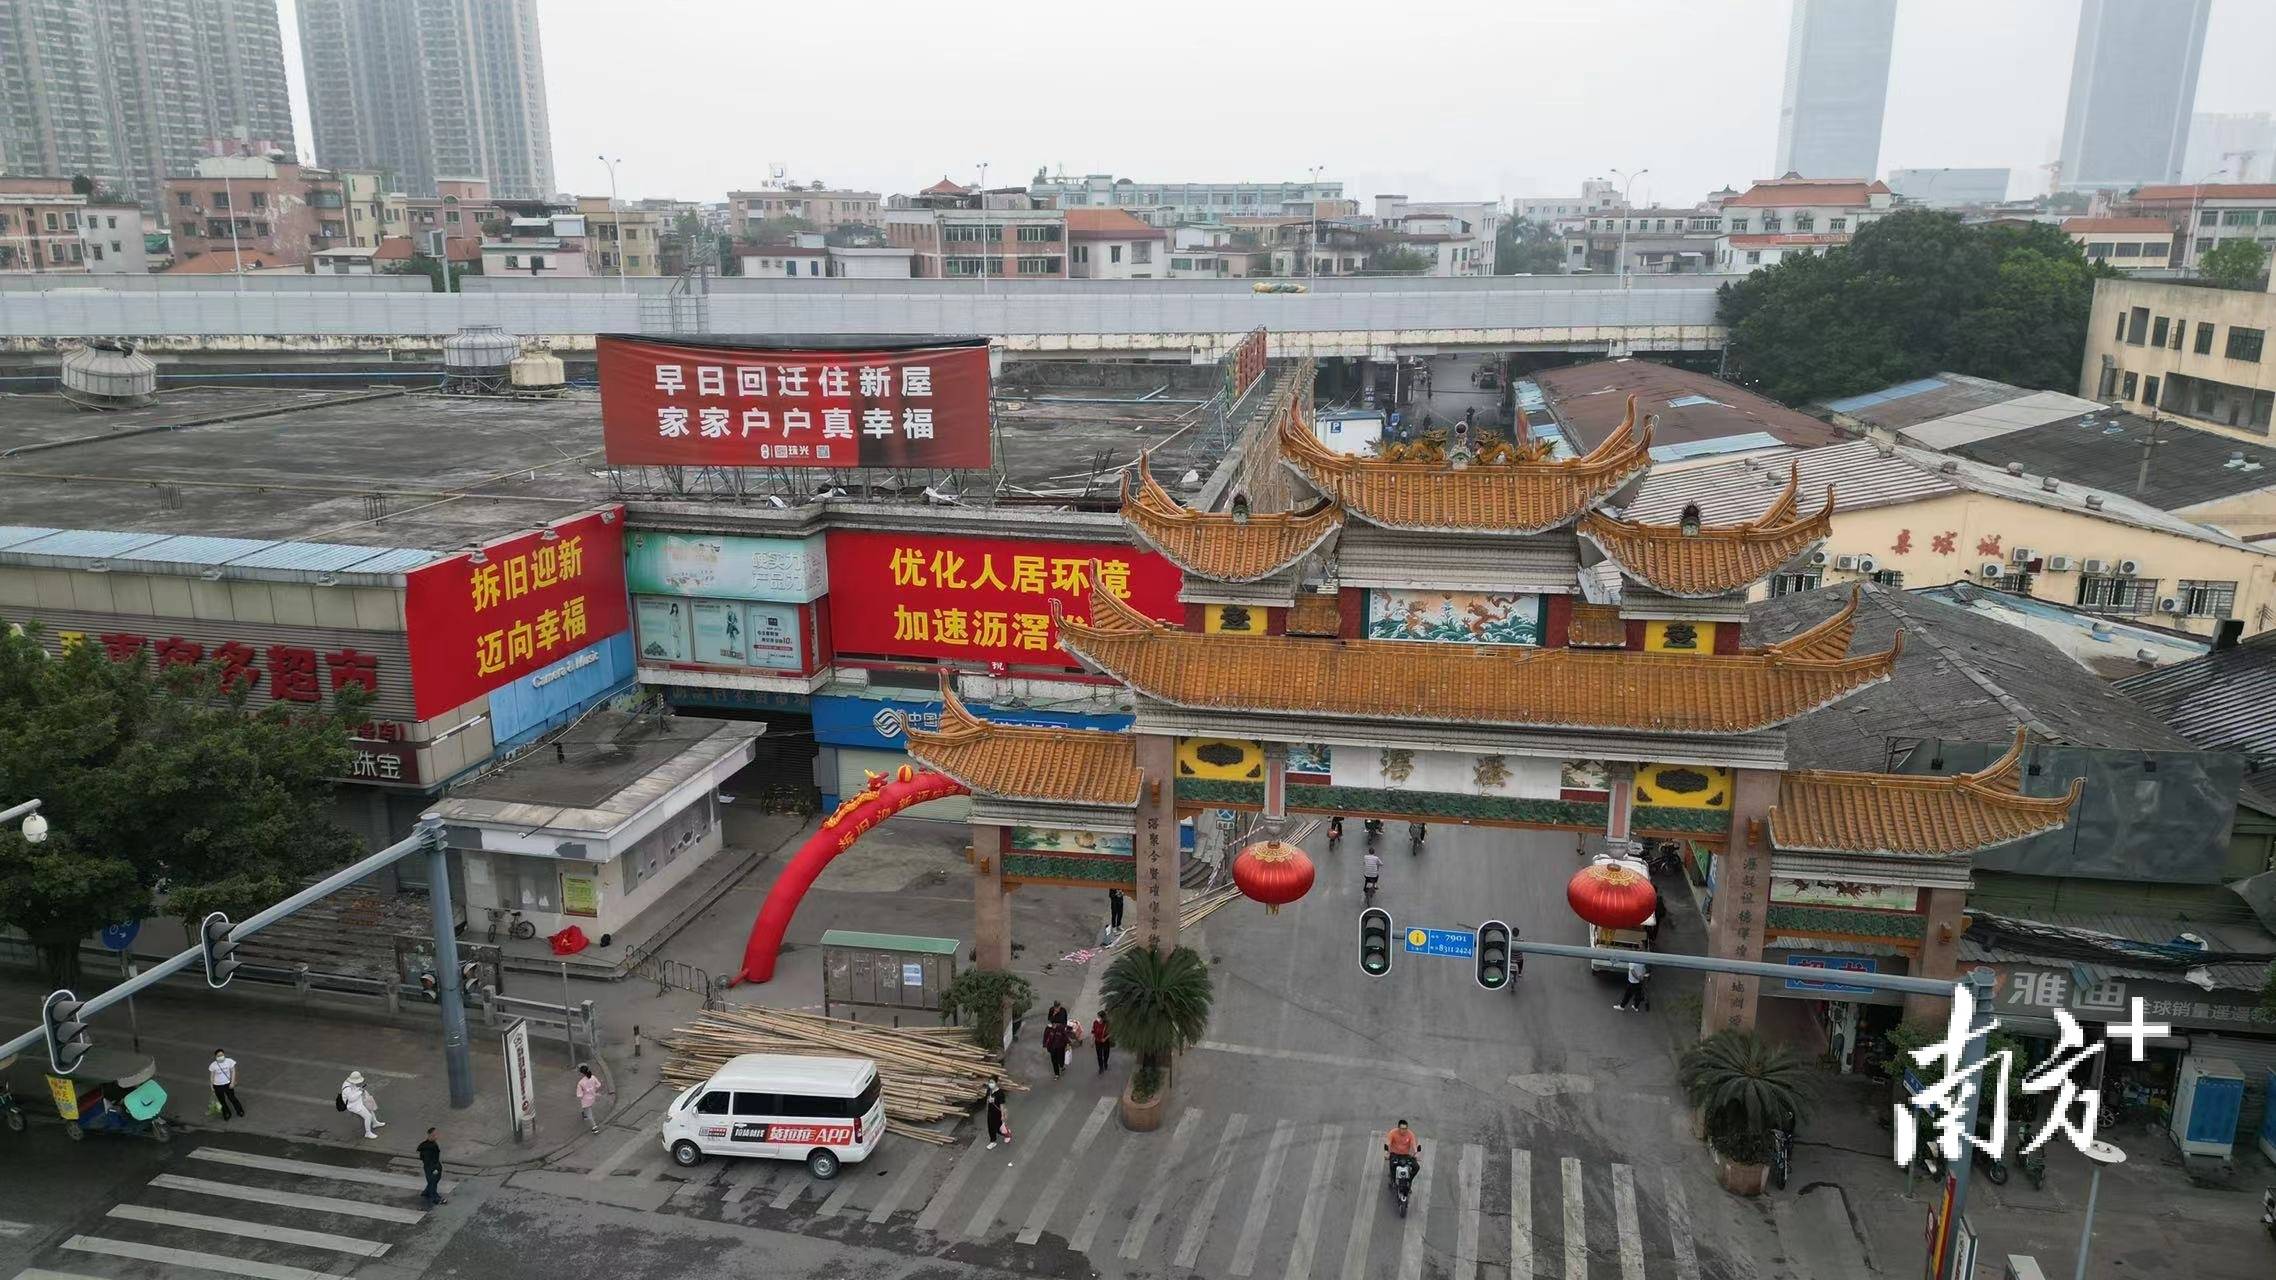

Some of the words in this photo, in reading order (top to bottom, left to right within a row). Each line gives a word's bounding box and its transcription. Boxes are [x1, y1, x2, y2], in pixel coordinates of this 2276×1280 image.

[655, 364, 934, 398] 早日回迁住新屋
[657, 406, 935, 440] 家家户户真幸福
[470, 535, 583, 613] 拆旧迎新
[889, 547, 1132, 600] 优化人居环境
[476, 595, 587, 678] 迈向幸福
[532, 666, 567, 688] Camera
[352, 750, 401, 780] 珠宝
[2007, 971, 2127, 1012] 雅迪
